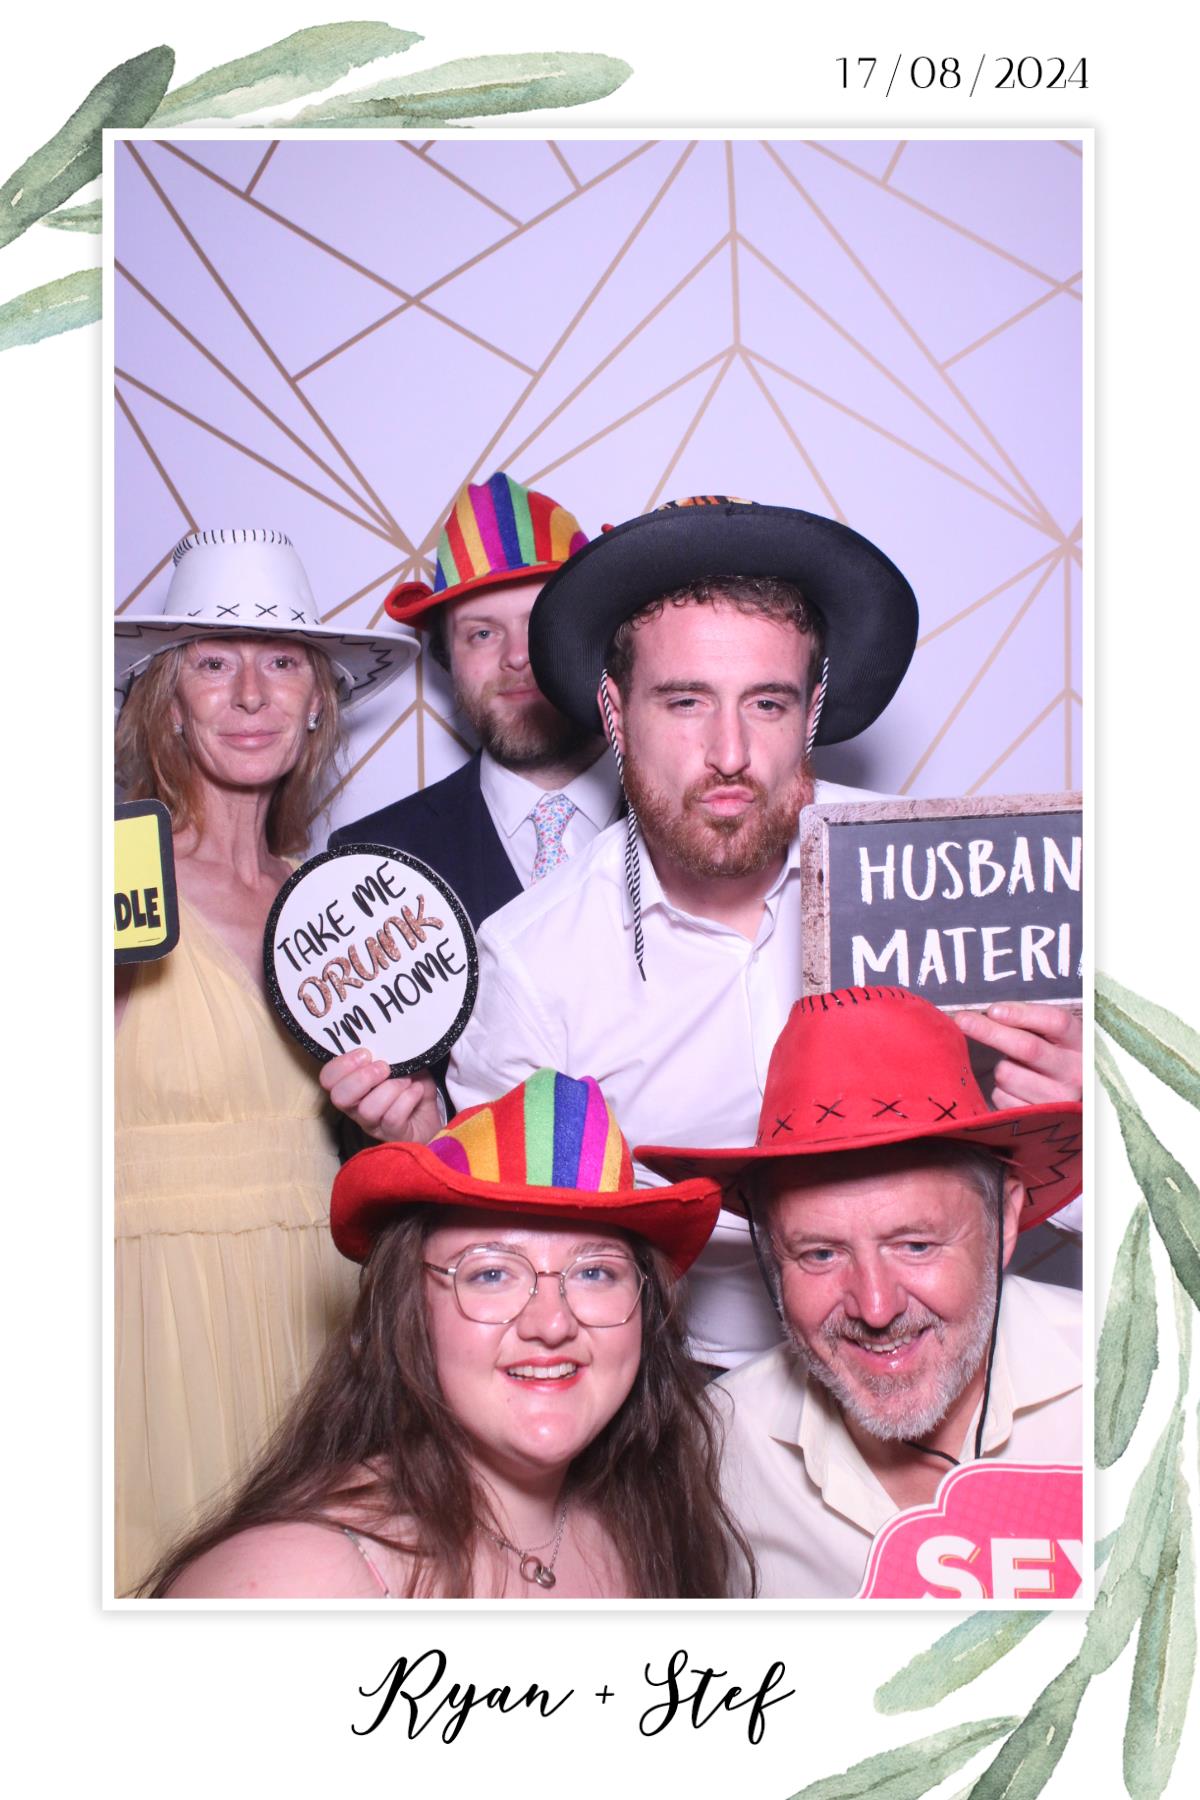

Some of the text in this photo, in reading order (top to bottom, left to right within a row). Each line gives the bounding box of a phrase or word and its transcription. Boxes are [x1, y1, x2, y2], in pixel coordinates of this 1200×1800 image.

[277, 861, 406, 971] TAKE ME
[859, 836, 1082, 905] HUSBAN
[298, 894, 444, 1018] DRUNK
[323, 938, 466, 1054] I'M HOME
[852, 923, 1083, 988] MATERI
